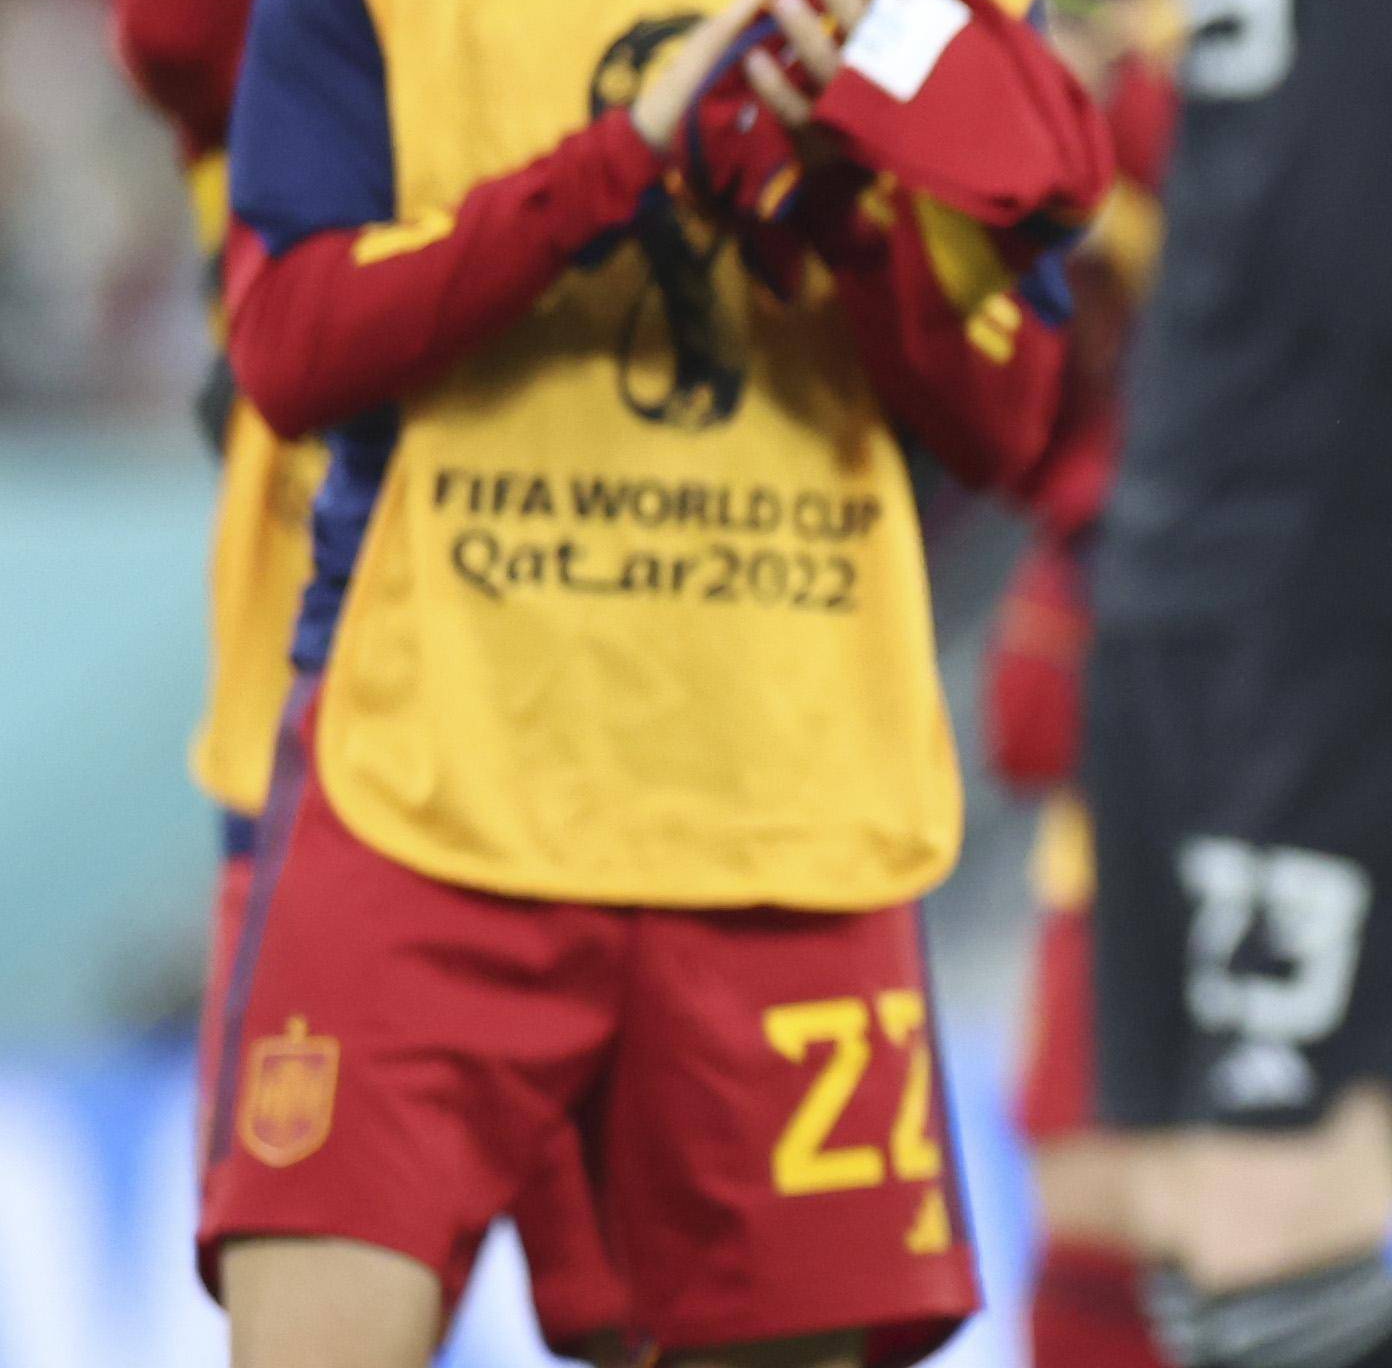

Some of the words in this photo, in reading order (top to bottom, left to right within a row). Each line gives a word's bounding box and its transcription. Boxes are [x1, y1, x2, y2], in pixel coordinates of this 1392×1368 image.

[432, 469, 554, 518] FIFA
[570, 475, 783, 535] WORLD
[792, 490, 884, 542] CUP
[762, 989, 943, 1198] 22
